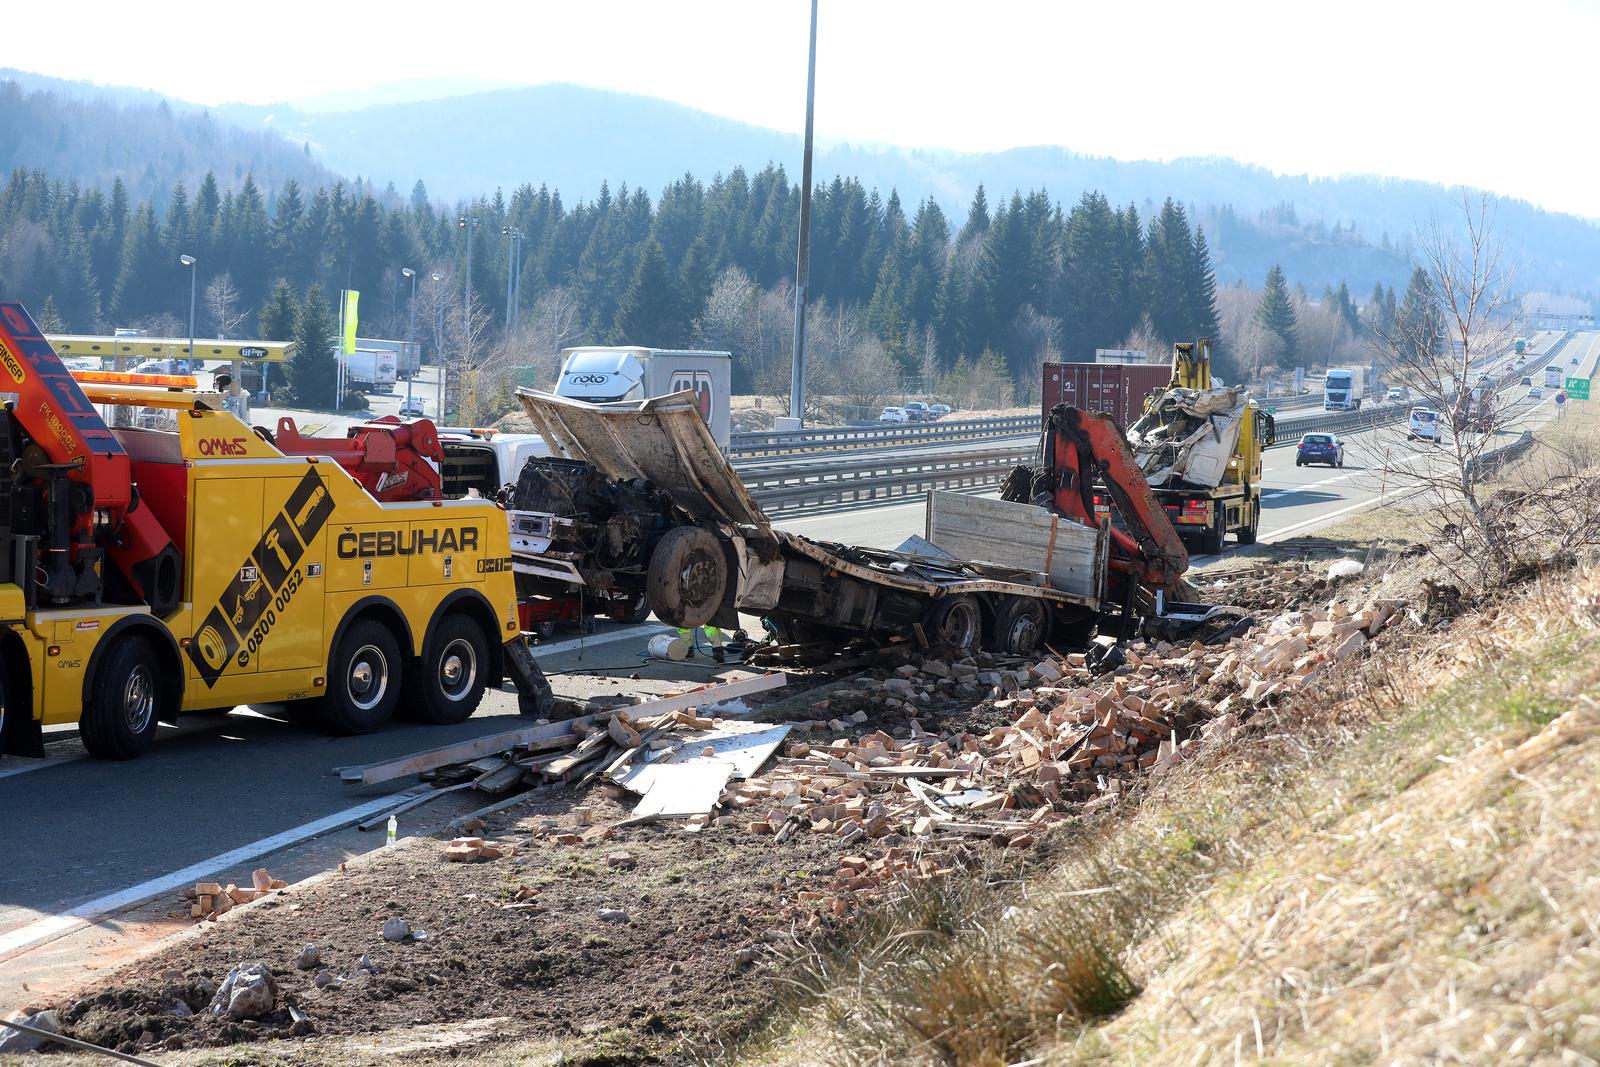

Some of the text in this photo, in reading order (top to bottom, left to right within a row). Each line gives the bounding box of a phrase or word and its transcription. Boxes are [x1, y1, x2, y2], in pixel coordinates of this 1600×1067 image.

[573, 374, 605, 383] roto
[39, 401, 52, 417] PK
[50, 415, 77, 450] 100002
[337, 526, 479, 559] ČEBUHAR
[247, 609, 276, 654] 0800
[275, 569, 304, 612] 0052
